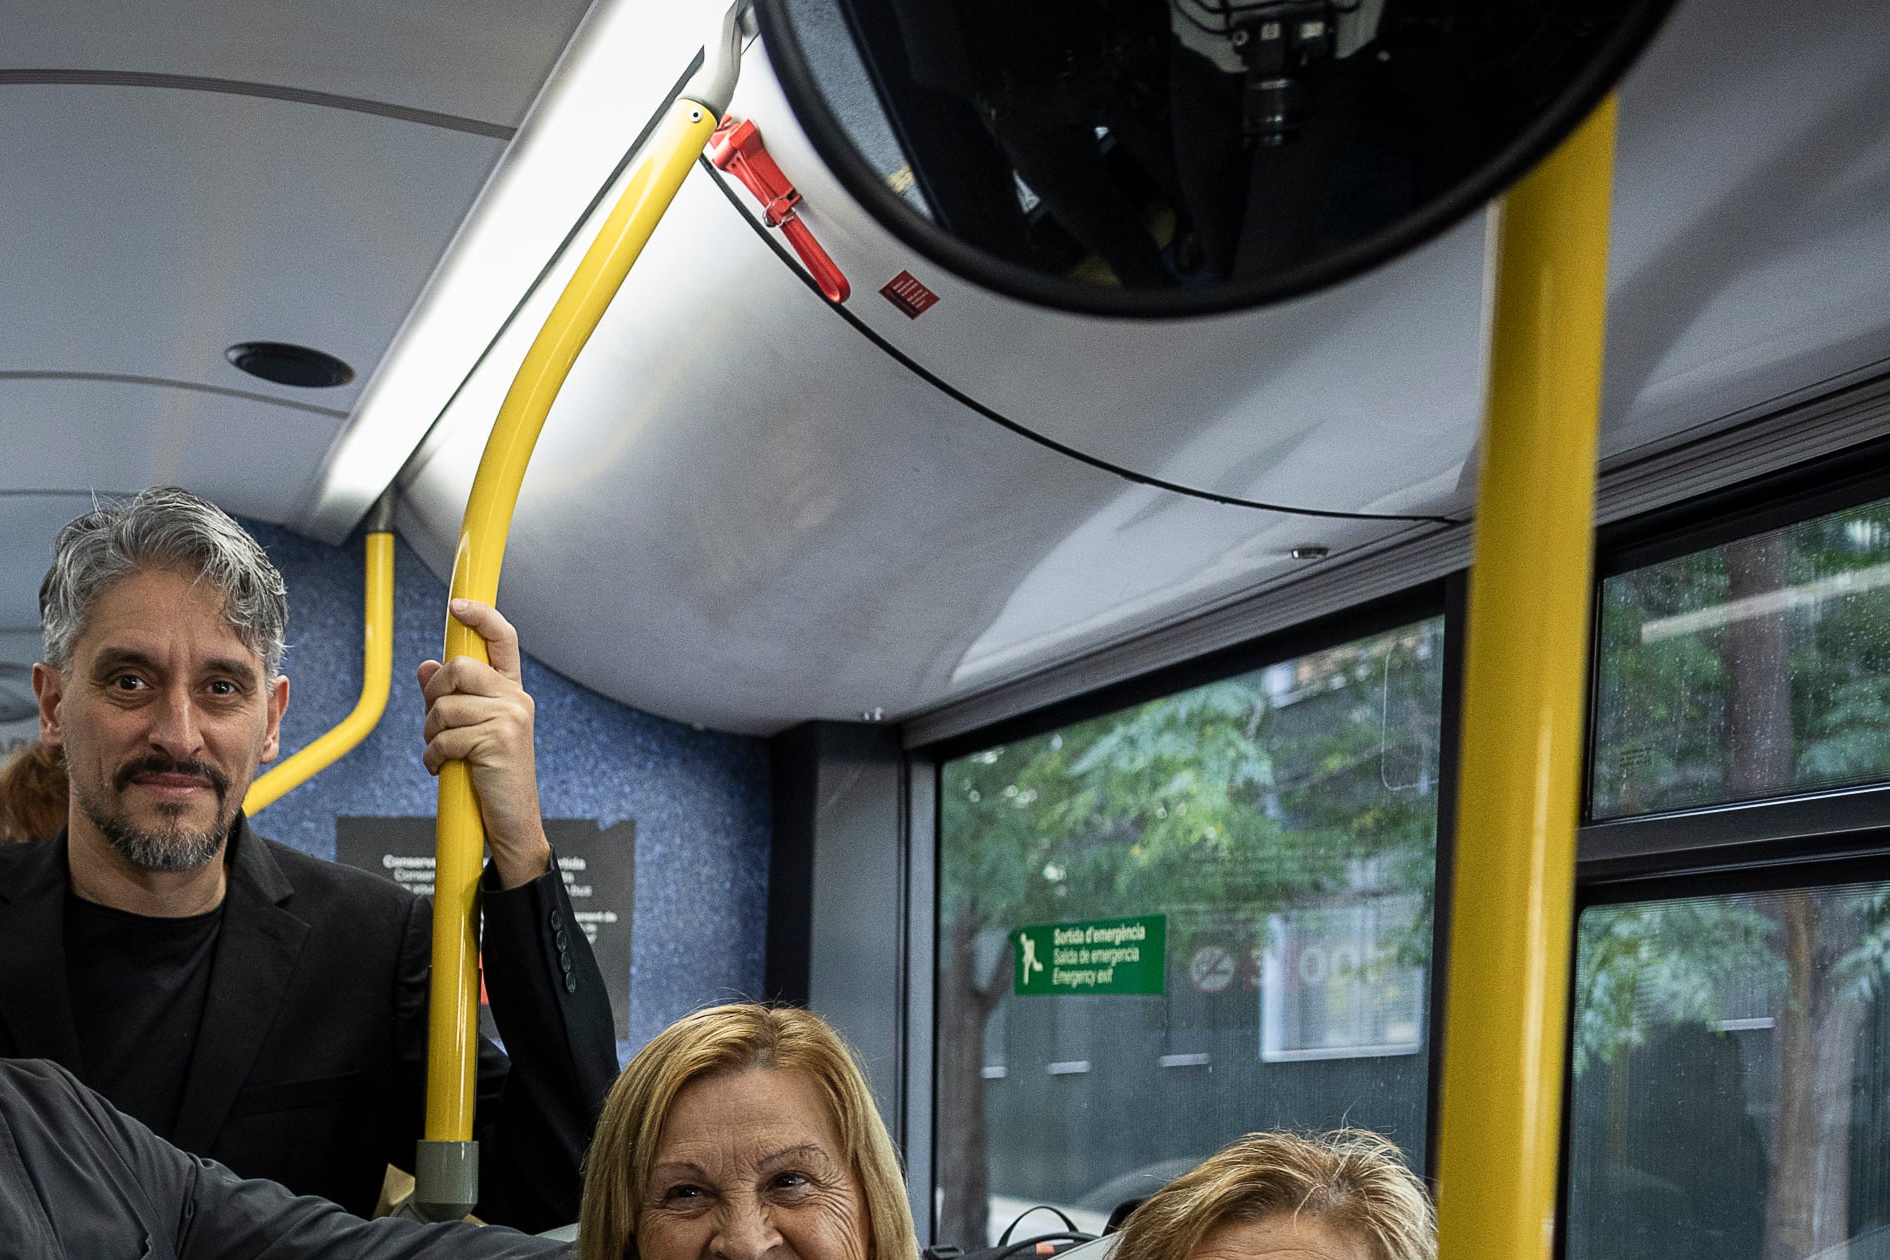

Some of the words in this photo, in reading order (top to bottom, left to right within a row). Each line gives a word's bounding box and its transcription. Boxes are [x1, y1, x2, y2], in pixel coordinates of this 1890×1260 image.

[1054, 926, 1084, 946] Sortida
[1053, 947, 1078, 966] Salida
[1079, 947, 1090, 964] de
[1091, 946, 1140, 967] emergencia
[1052, 966, 1096, 988] Emergency
